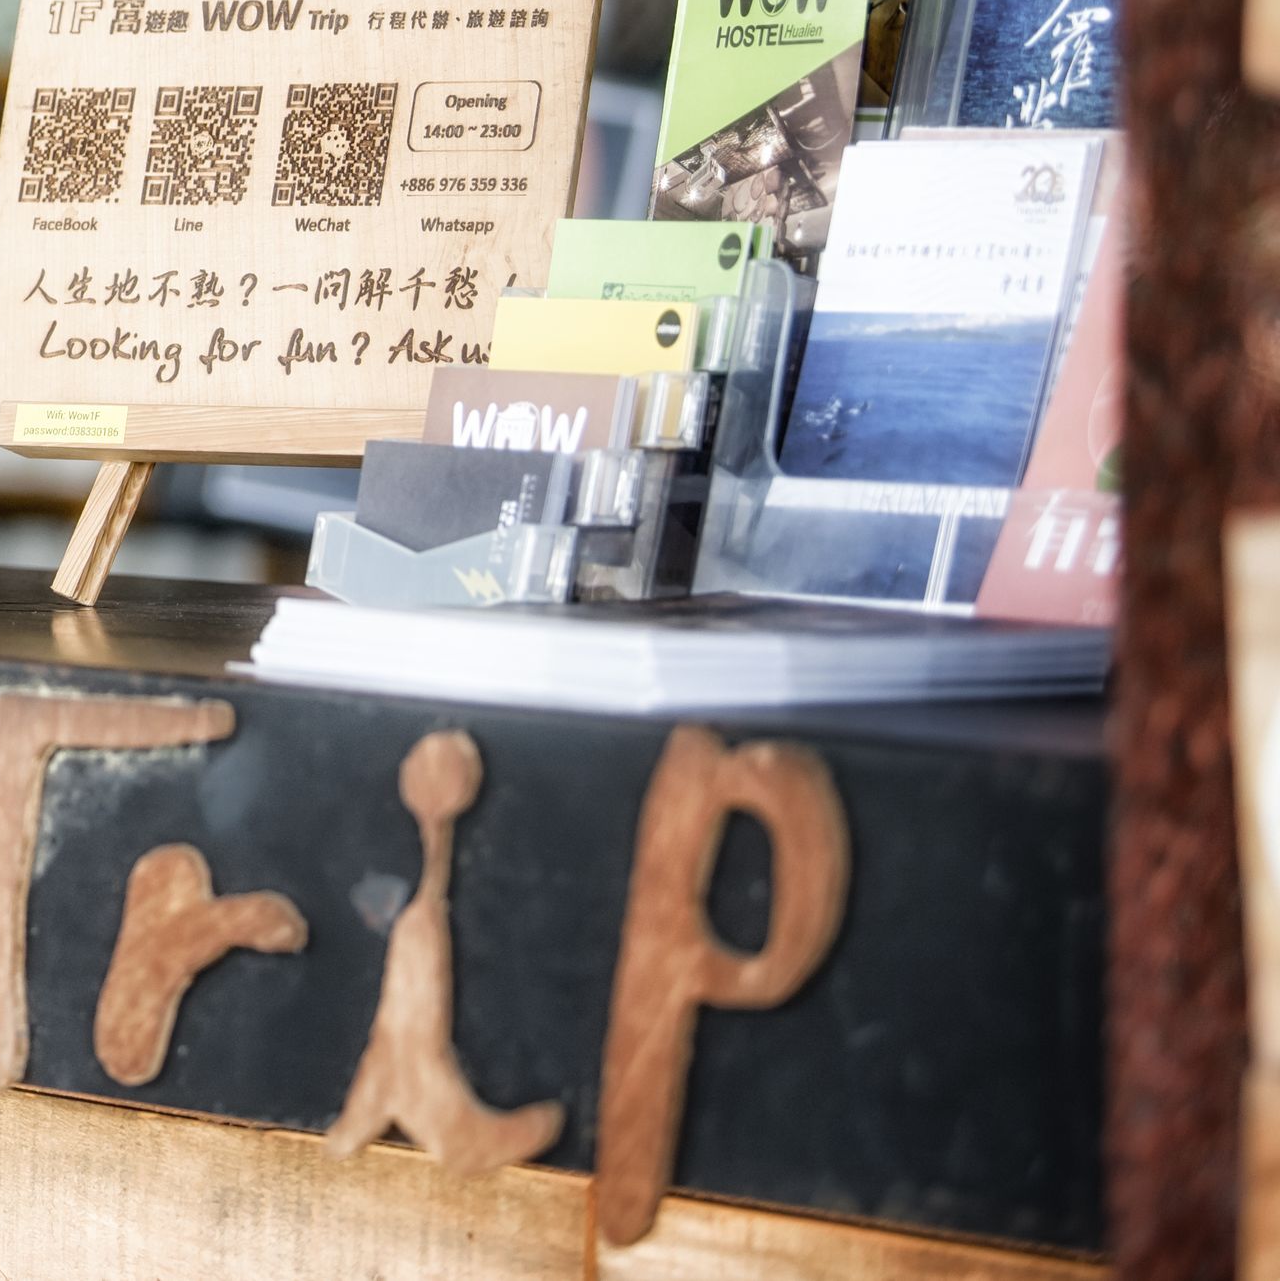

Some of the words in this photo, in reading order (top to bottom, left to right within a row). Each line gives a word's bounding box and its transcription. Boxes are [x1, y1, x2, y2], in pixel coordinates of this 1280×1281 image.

[308, 9, 349, 35] Trip
[716, 24, 786, 48] HOSTEL
[784, 23, 823, 38] Hualien
[445, 94, 508, 111] Opening
[423, 124, 465, 139] 14:00
[479, 124, 522, 138] 23:00
[400, 177, 435, 192] +886
[439, 178, 466, 192] 976
[469, 177, 497, 192] 359
[500, 177, 528, 192] 336
[32, 217, 98, 232] FaceBook
[174, 217, 204, 232] Line
[295, 217, 351, 232] WeChat
[421, 217, 494, 235] Whatsapp
[40, 320, 182, 383] Looking
[199, 327, 262, 375] for
[277, 328, 338, 375] fun
[388, 328, 454, 365] Ask
